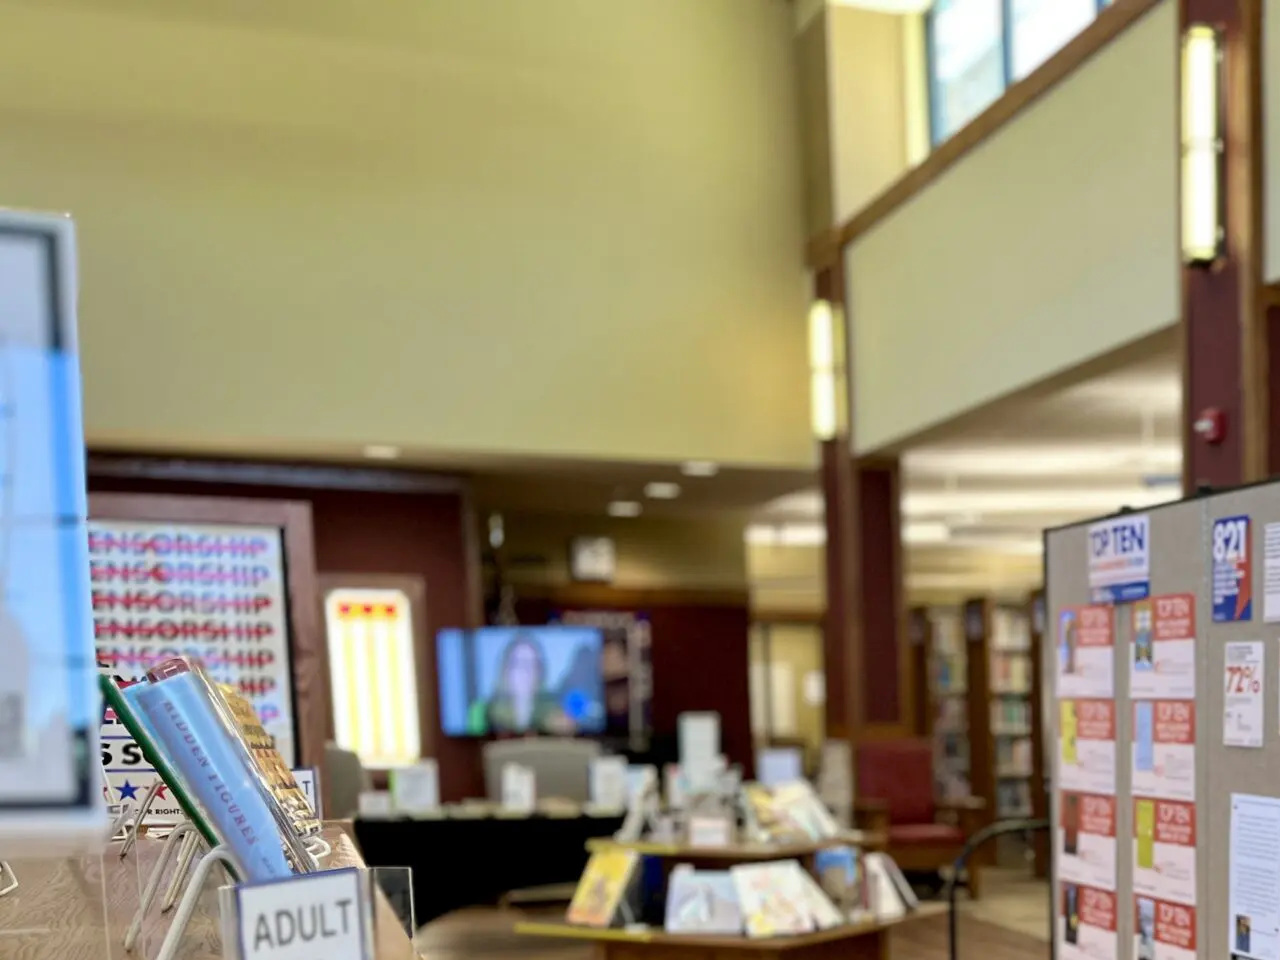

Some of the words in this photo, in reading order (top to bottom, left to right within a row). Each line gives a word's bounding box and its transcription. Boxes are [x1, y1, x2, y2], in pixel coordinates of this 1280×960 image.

[88, 531, 267, 559] ENSORSHIP
[1112, 522, 1144, 555] TEN
[1213, 520, 1247, 563] 821
[90, 560, 269, 587] ENSORSHIP
[92, 590, 273, 614] ENSORSHIP
[94, 618, 274, 643] ENSORSHIP
[1226, 665, 1260, 694] 72%
[163, 701, 210, 768] HIDDEN
[208, 771, 259, 846] FIGURES
[252, 899, 353, 952] ADULT
